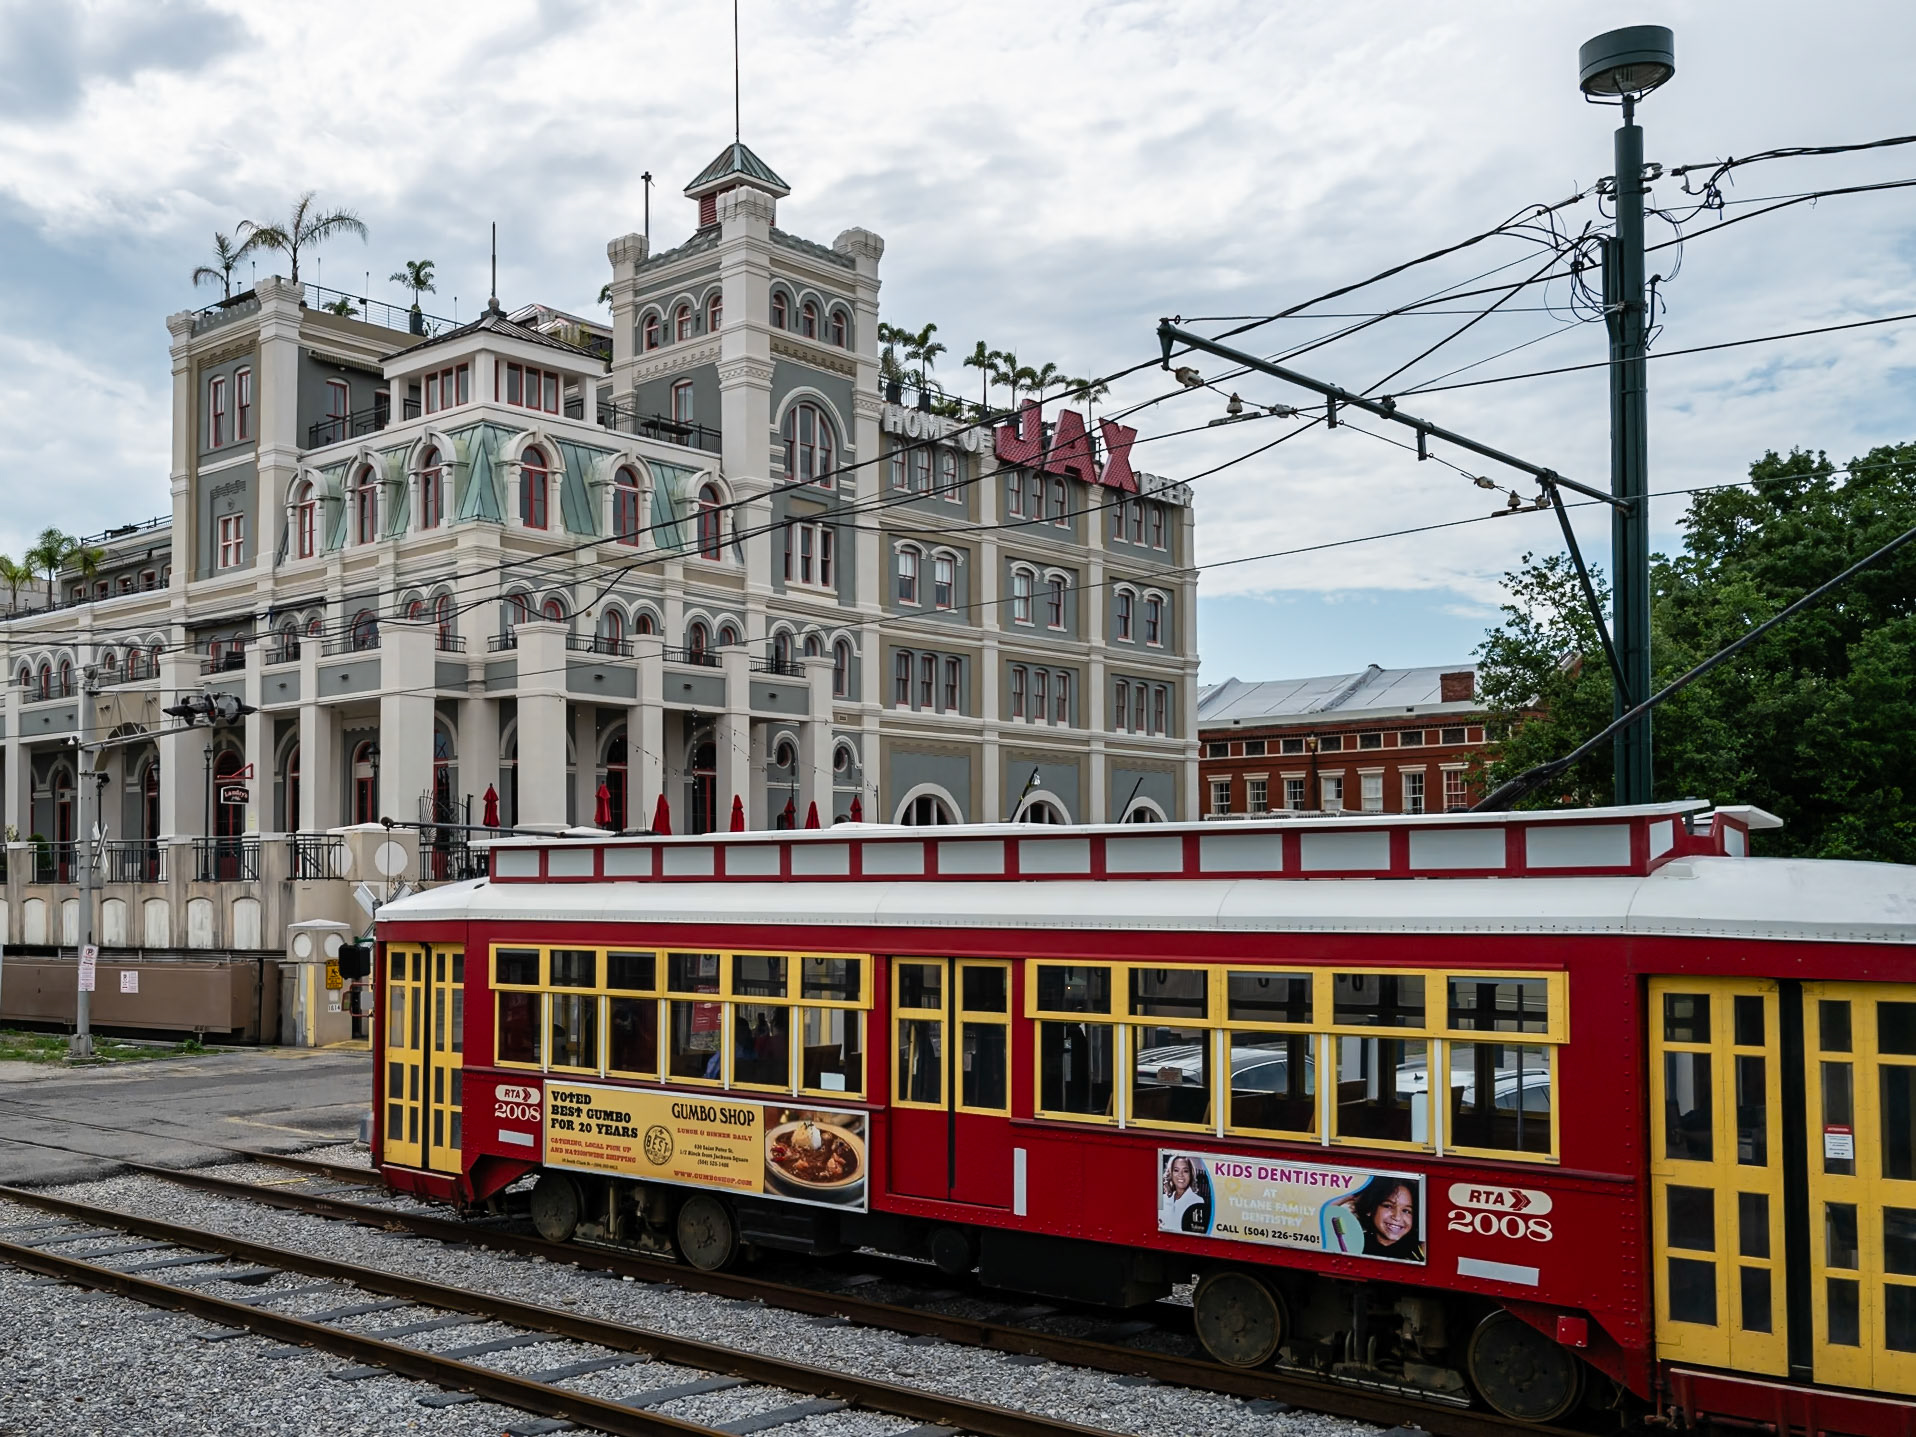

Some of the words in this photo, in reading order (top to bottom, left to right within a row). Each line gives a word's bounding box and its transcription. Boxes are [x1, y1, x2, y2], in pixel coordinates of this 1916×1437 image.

[883, 402, 961, 447] HOME
[958, 422, 993, 454] OF
[995, 398, 1138, 495] JAX
[504, 1088, 521, 1099] RTA
[551, 1090, 592, 1105] VOTED
[494, 1102, 541, 1122] 2008
[551, 1104, 583, 1118] BEST
[586, 1108, 632, 1123] GUMBO
[671, 1102, 717, 1123] GUMBO
[719, 1107, 755, 1127] SHOP
[551, 1117, 575, 1131] FOR
[578, 1121, 593, 1133] 20
[595, 1123, 638, 1139] YEARS
[550, 1137, 583, 1147] CATERING,
[584, 1141, 604, 1150] LOCAL
[732, 1133, 753, 1142] DAILY
[550, 1146, 564, 1154] AND
[673, 1169, 753, 1187] WWW.GUMBOSHOP.COM
[1214, 1162, 1253, 1179] KIDS
[1257, 1166, 1354, 1189] DENTISTRY
[1262, 1188, 1278, 1198] AT
[1468, 1189, 1506, 1206] RTA
[1228, 1196, 1273, 1211] TULANE
[1275, 1201, 1317, 1216] FAMILY
[1241, 1211, 1303, 1227] DENTISTRY
[1447, 1209, 1553, 1242] 2008
[1216, 1223, 1240, 1234] CALL
[1243, 1225, 1270, 1238] (504)
[1271, 1230, 1321, 1243] 226-5740!
